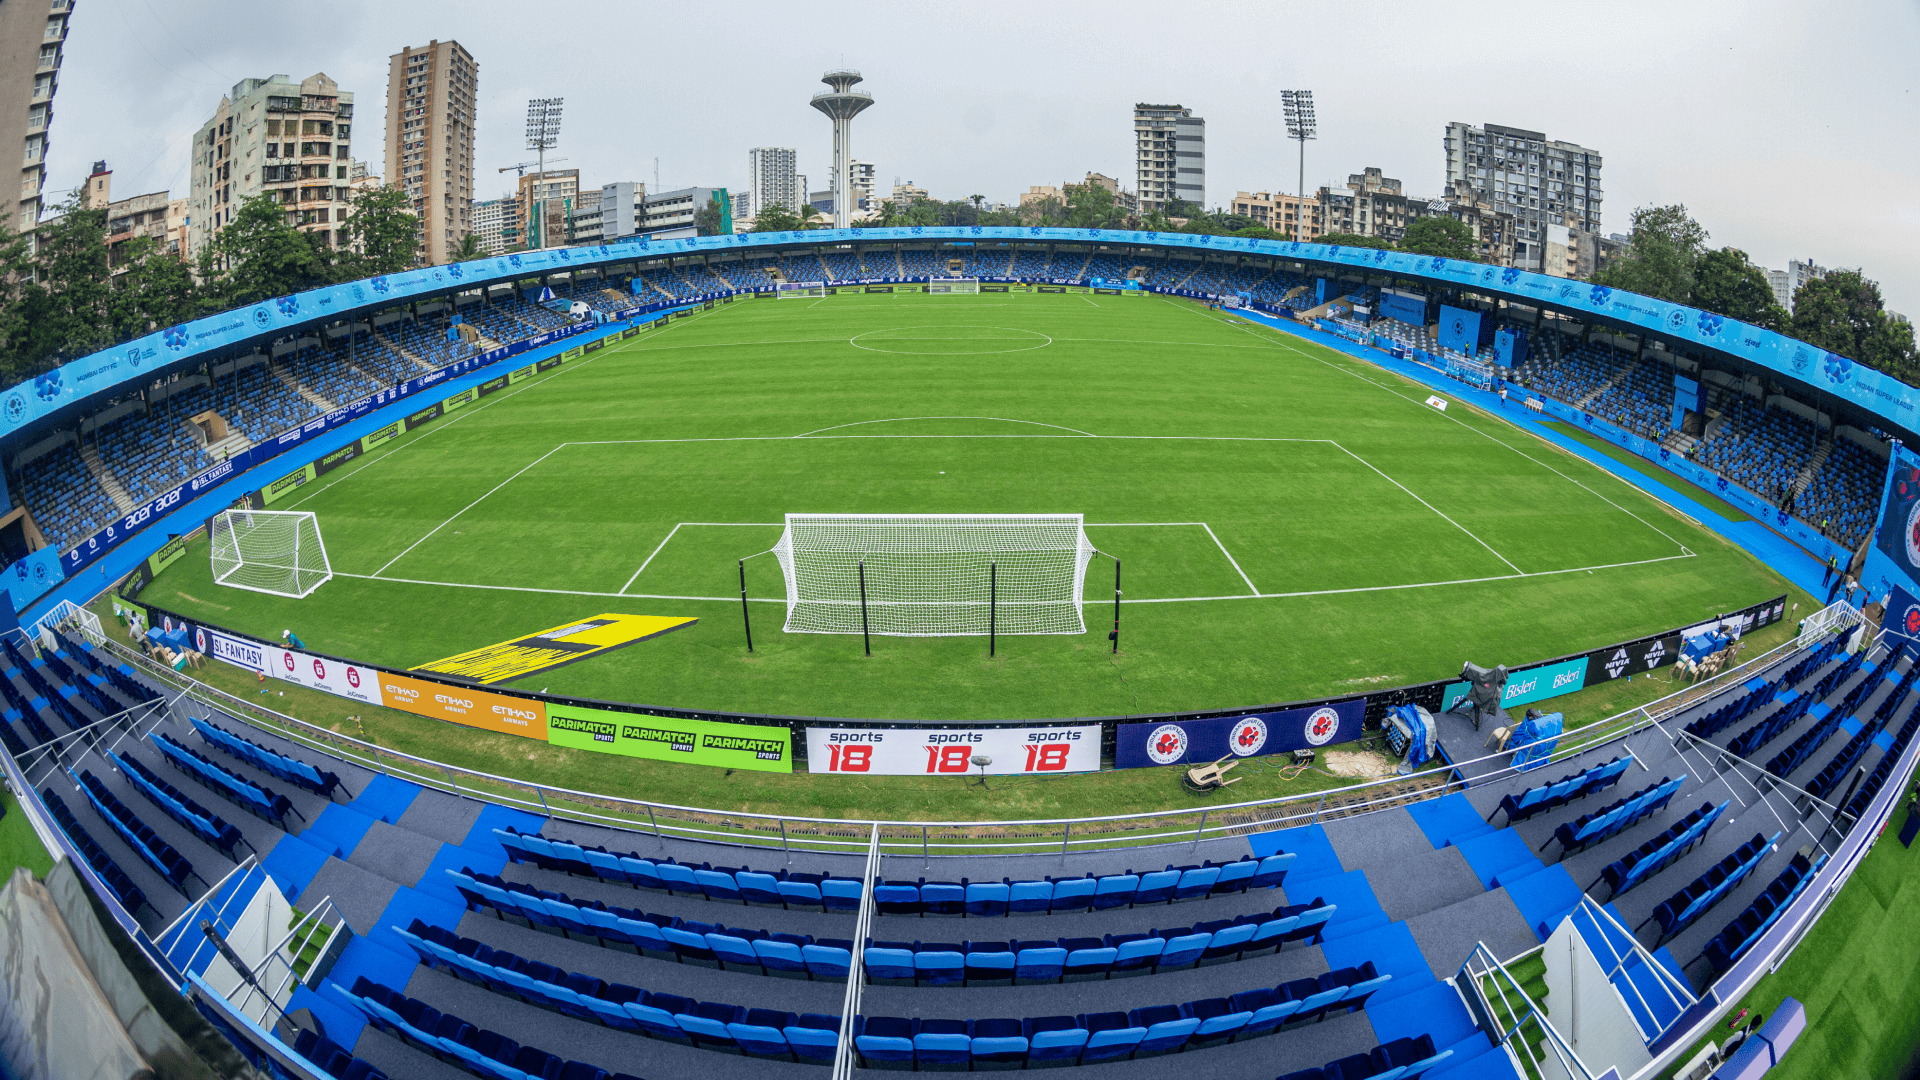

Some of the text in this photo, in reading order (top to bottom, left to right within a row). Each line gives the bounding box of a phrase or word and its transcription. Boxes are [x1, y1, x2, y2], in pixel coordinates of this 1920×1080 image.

[1855, 381, 1914, 412] INDIAN SUPER LEAGUE
[370, 424, 397, 443] PARIMATCH
[323, 445, 354, 465] PARIMATCH
[208, 464, 233, 480] FANTASY
[272, 469, 305, 494] PARIMATCH
[155, 487, 183, 513] acer
[125, 503, 153, 530] acer
[225, 643, 263, 666] FANTASY
[1644, 649, 1666, 660] NIVIA
[1605, 658, 1630, 670] NIVIA
[1553, 667, 1581, 689] Bisleri
[385, 684, 419, 698] ETIHAD
[1505, 677, 1537, 700] Bisleri
[394, 695, 414, 704] AIRWAYS
[434, 694, 473, 708] ETIHAD
[444, 705, 467, 715] AIRWAYS
[492, 705, 536, 720] ETIHAD
[503, 716, 528, 727] AIRWAYS
[552, 717, 615, 735] PARIMATCH
[595, 734, 614, 742] SPORTS
[623, 726, 695, 744] PARIMATCH
[829, 731, 884, 744] sports
[928, 731, 983, 744] sports
[1028, 730, 1081, 743] sports
[672, 743, 693, 752] SPORTS
[703, 736, 783, 752] PARIMATCH
[757, 752, 780, 760] SPORTS
[824, 744, 873, 772] 18
[922, 745, 972, 773] 18
[1022, 743, 1070, 771] 18
